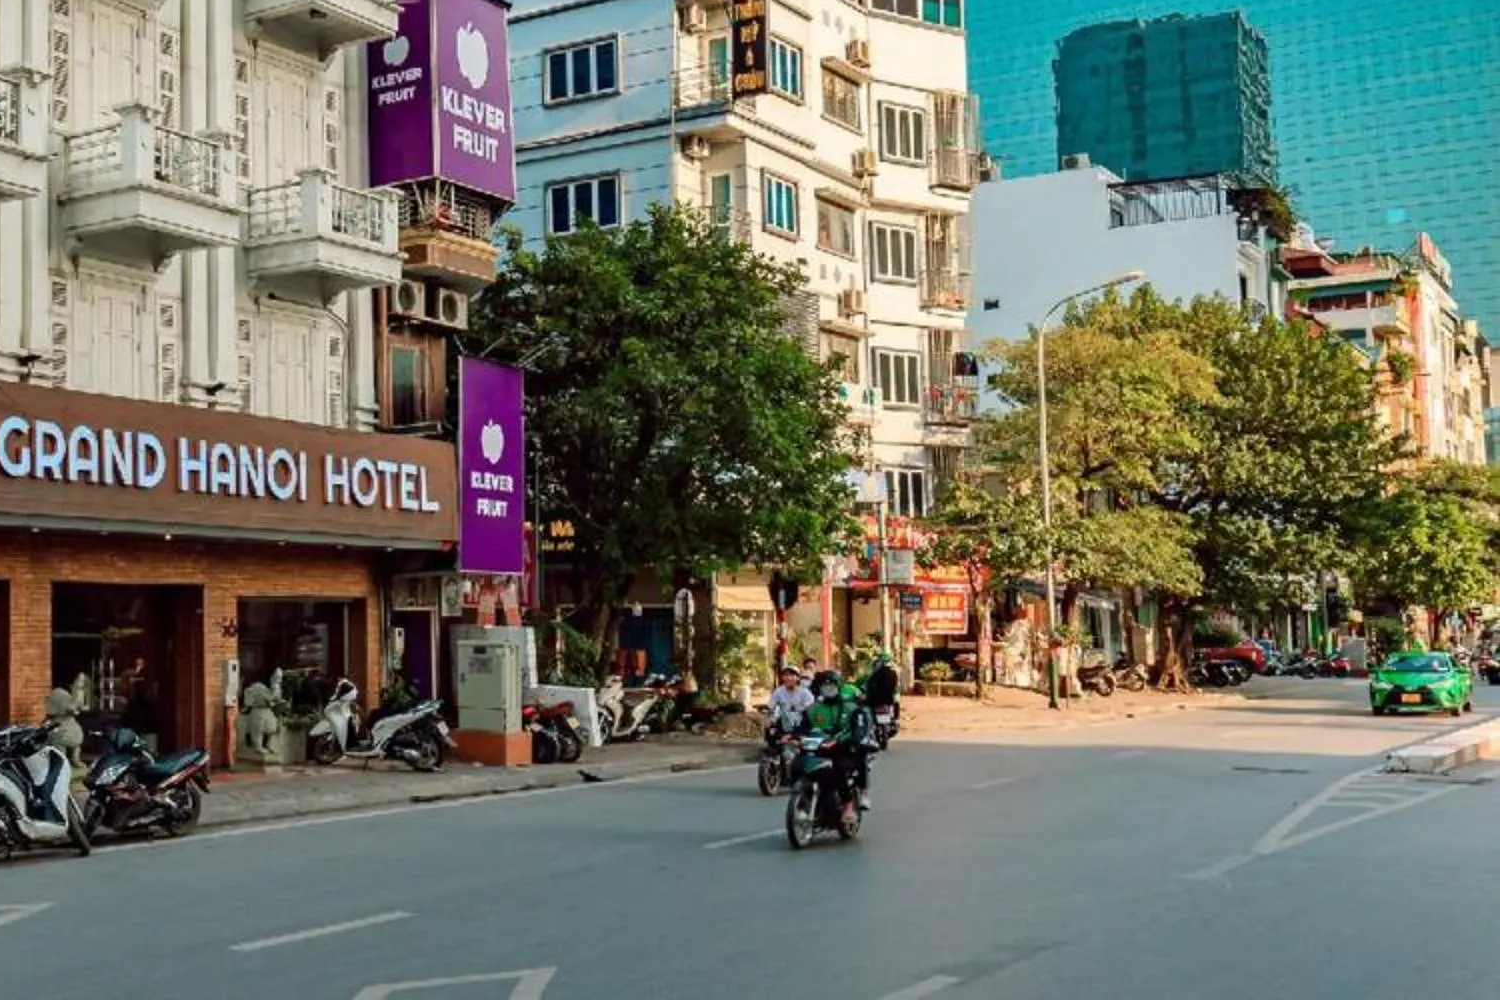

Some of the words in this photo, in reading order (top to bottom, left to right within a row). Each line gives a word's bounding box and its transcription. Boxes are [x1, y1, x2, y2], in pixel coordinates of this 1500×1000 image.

[371, 67, 423, 89] KLEVER
[377, 86, 416, 106] FRUIT
[441, 85, 506, 133] KLEVER
[453, 123, 499, 162] FRUIT
[177, 436, 308, 502] HANOI
[323, 452, 441, 513] HOTEL
[471, 471, 514, 493] KLEVER
[477, 498, 509, 517] FRUIT
